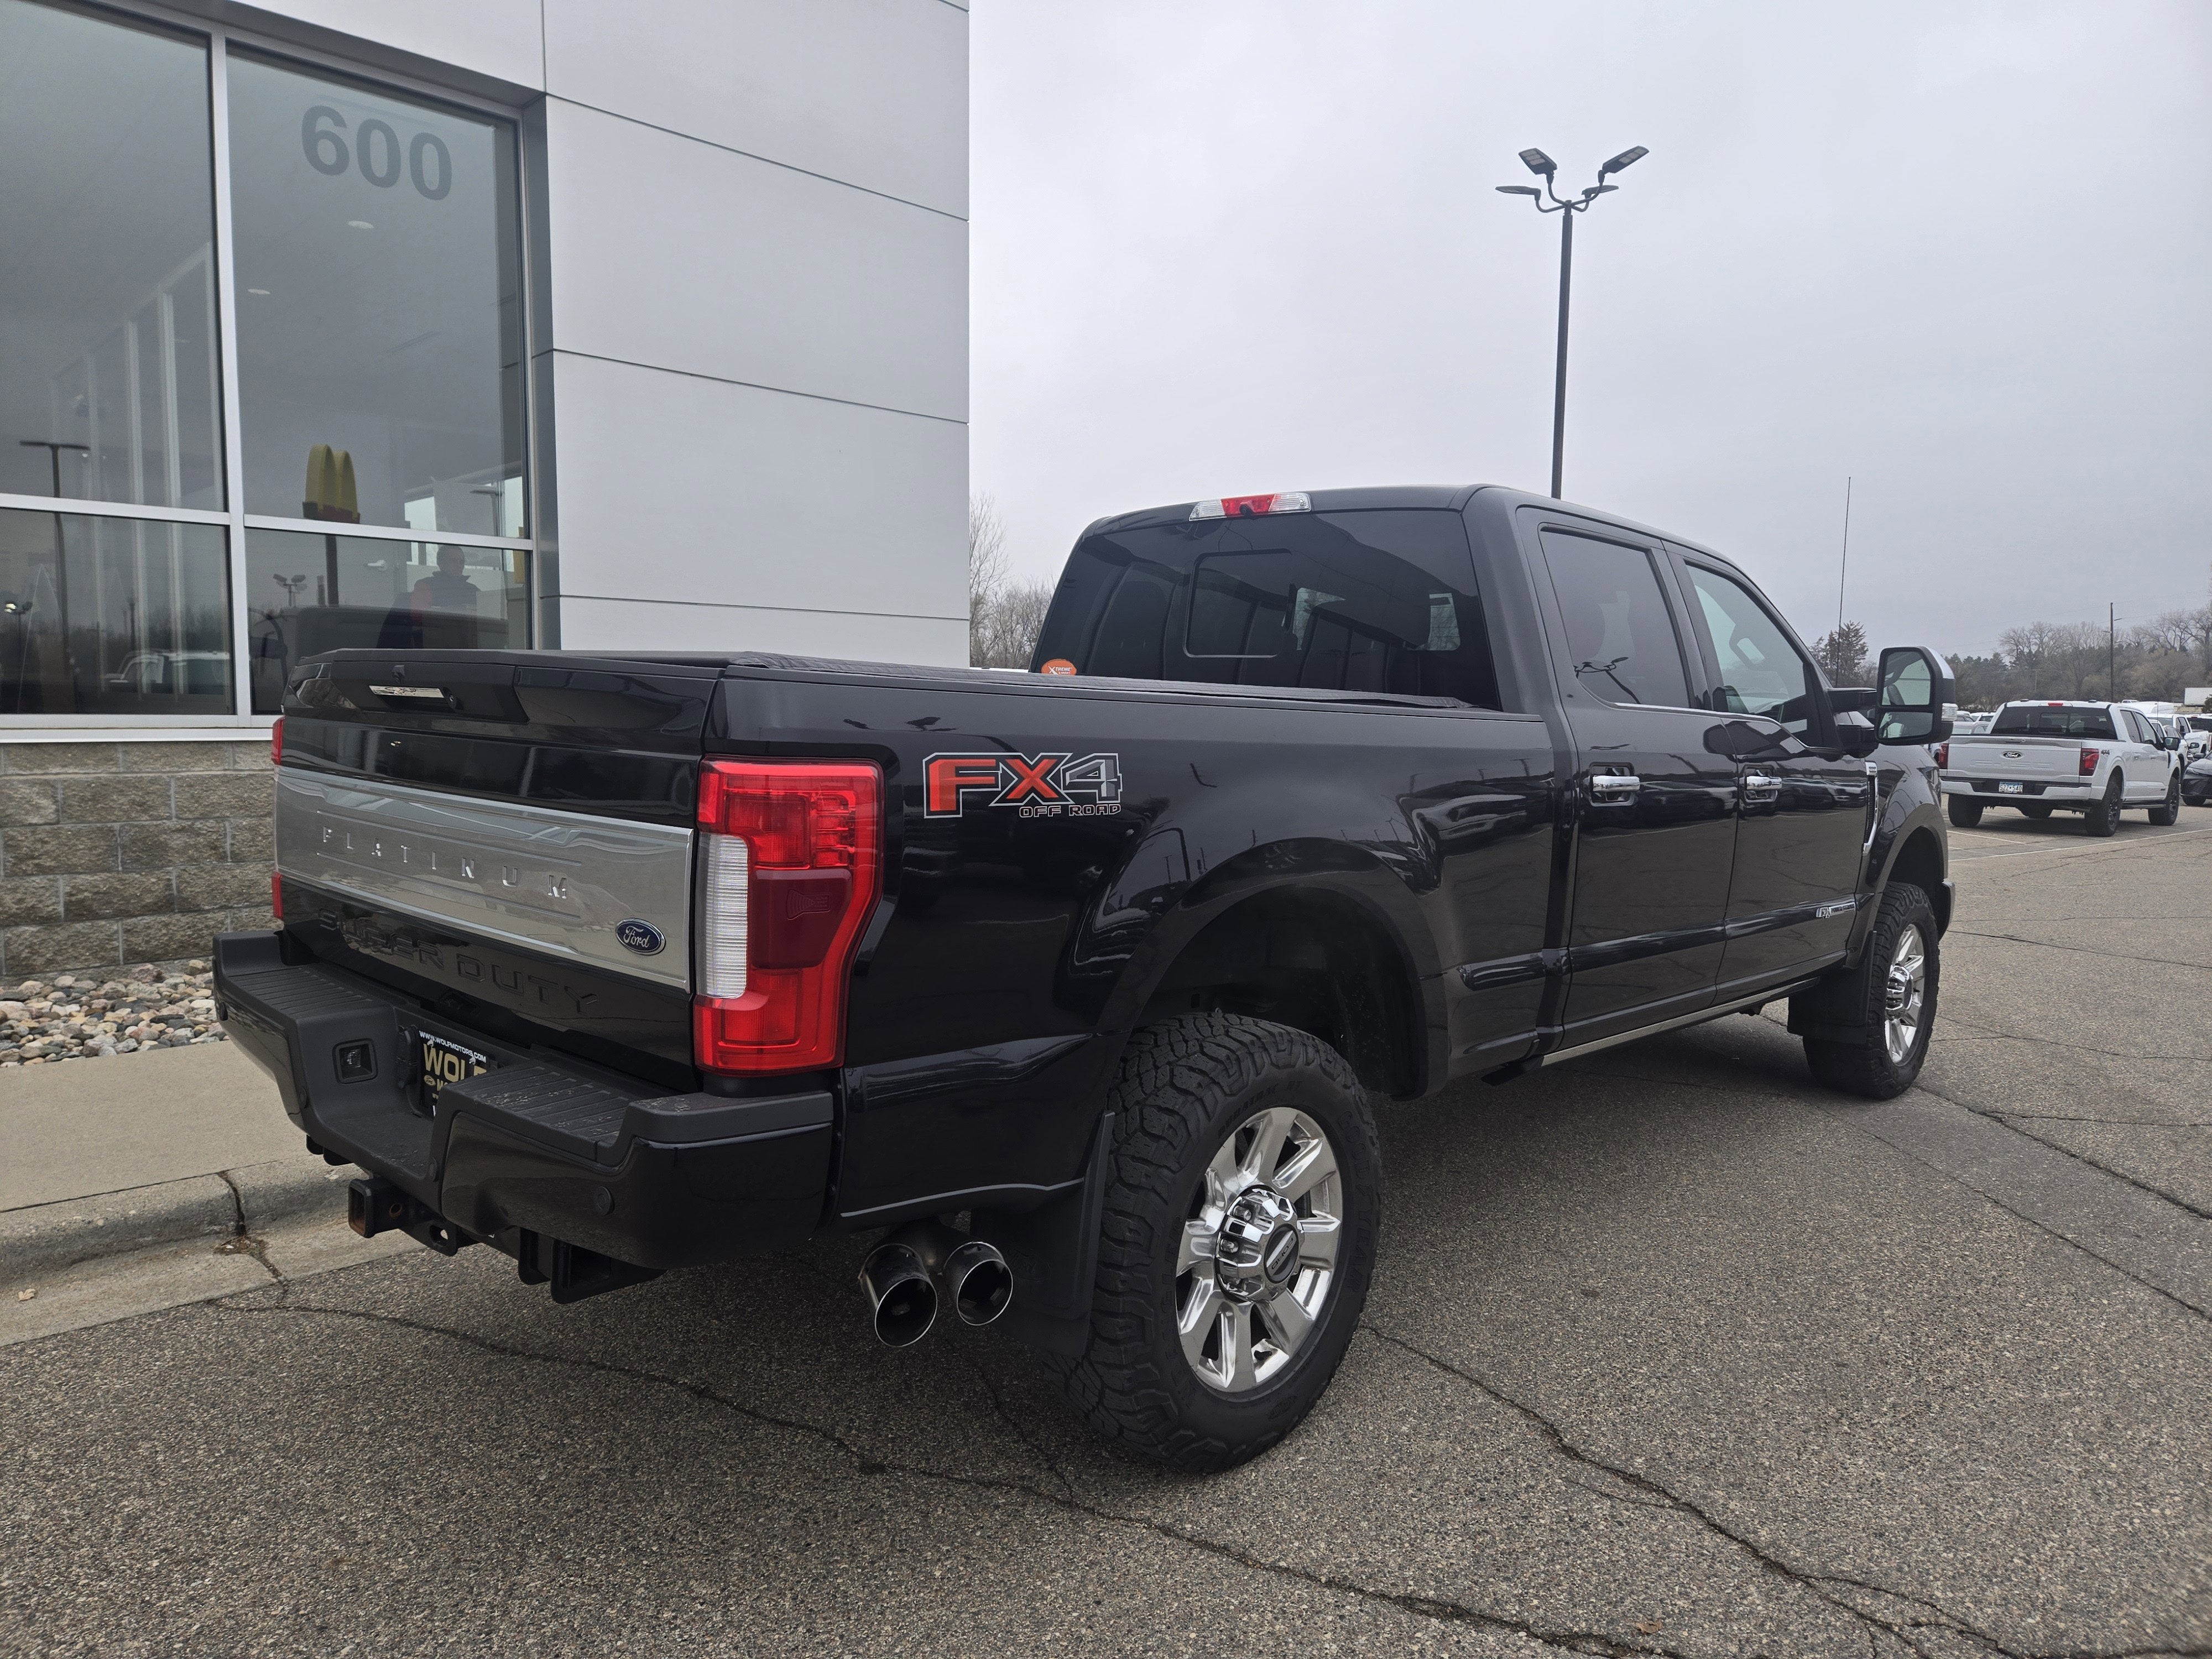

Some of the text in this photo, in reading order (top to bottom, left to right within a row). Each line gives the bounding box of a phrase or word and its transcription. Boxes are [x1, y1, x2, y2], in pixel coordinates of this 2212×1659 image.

[301, 105, 453, 202] 600
[923, 753, 1123, 819] FX4
[1019, 804, 1122, 818] OFF ROAD
[322, 826, 567, 900] PLATINUM
[317, 907, 599, 1015] SUPER DUTY
[623, 925, 650, 948] Ford
[419, 1030, 487, 1063] WWW.WOLFMOTORS.COM
